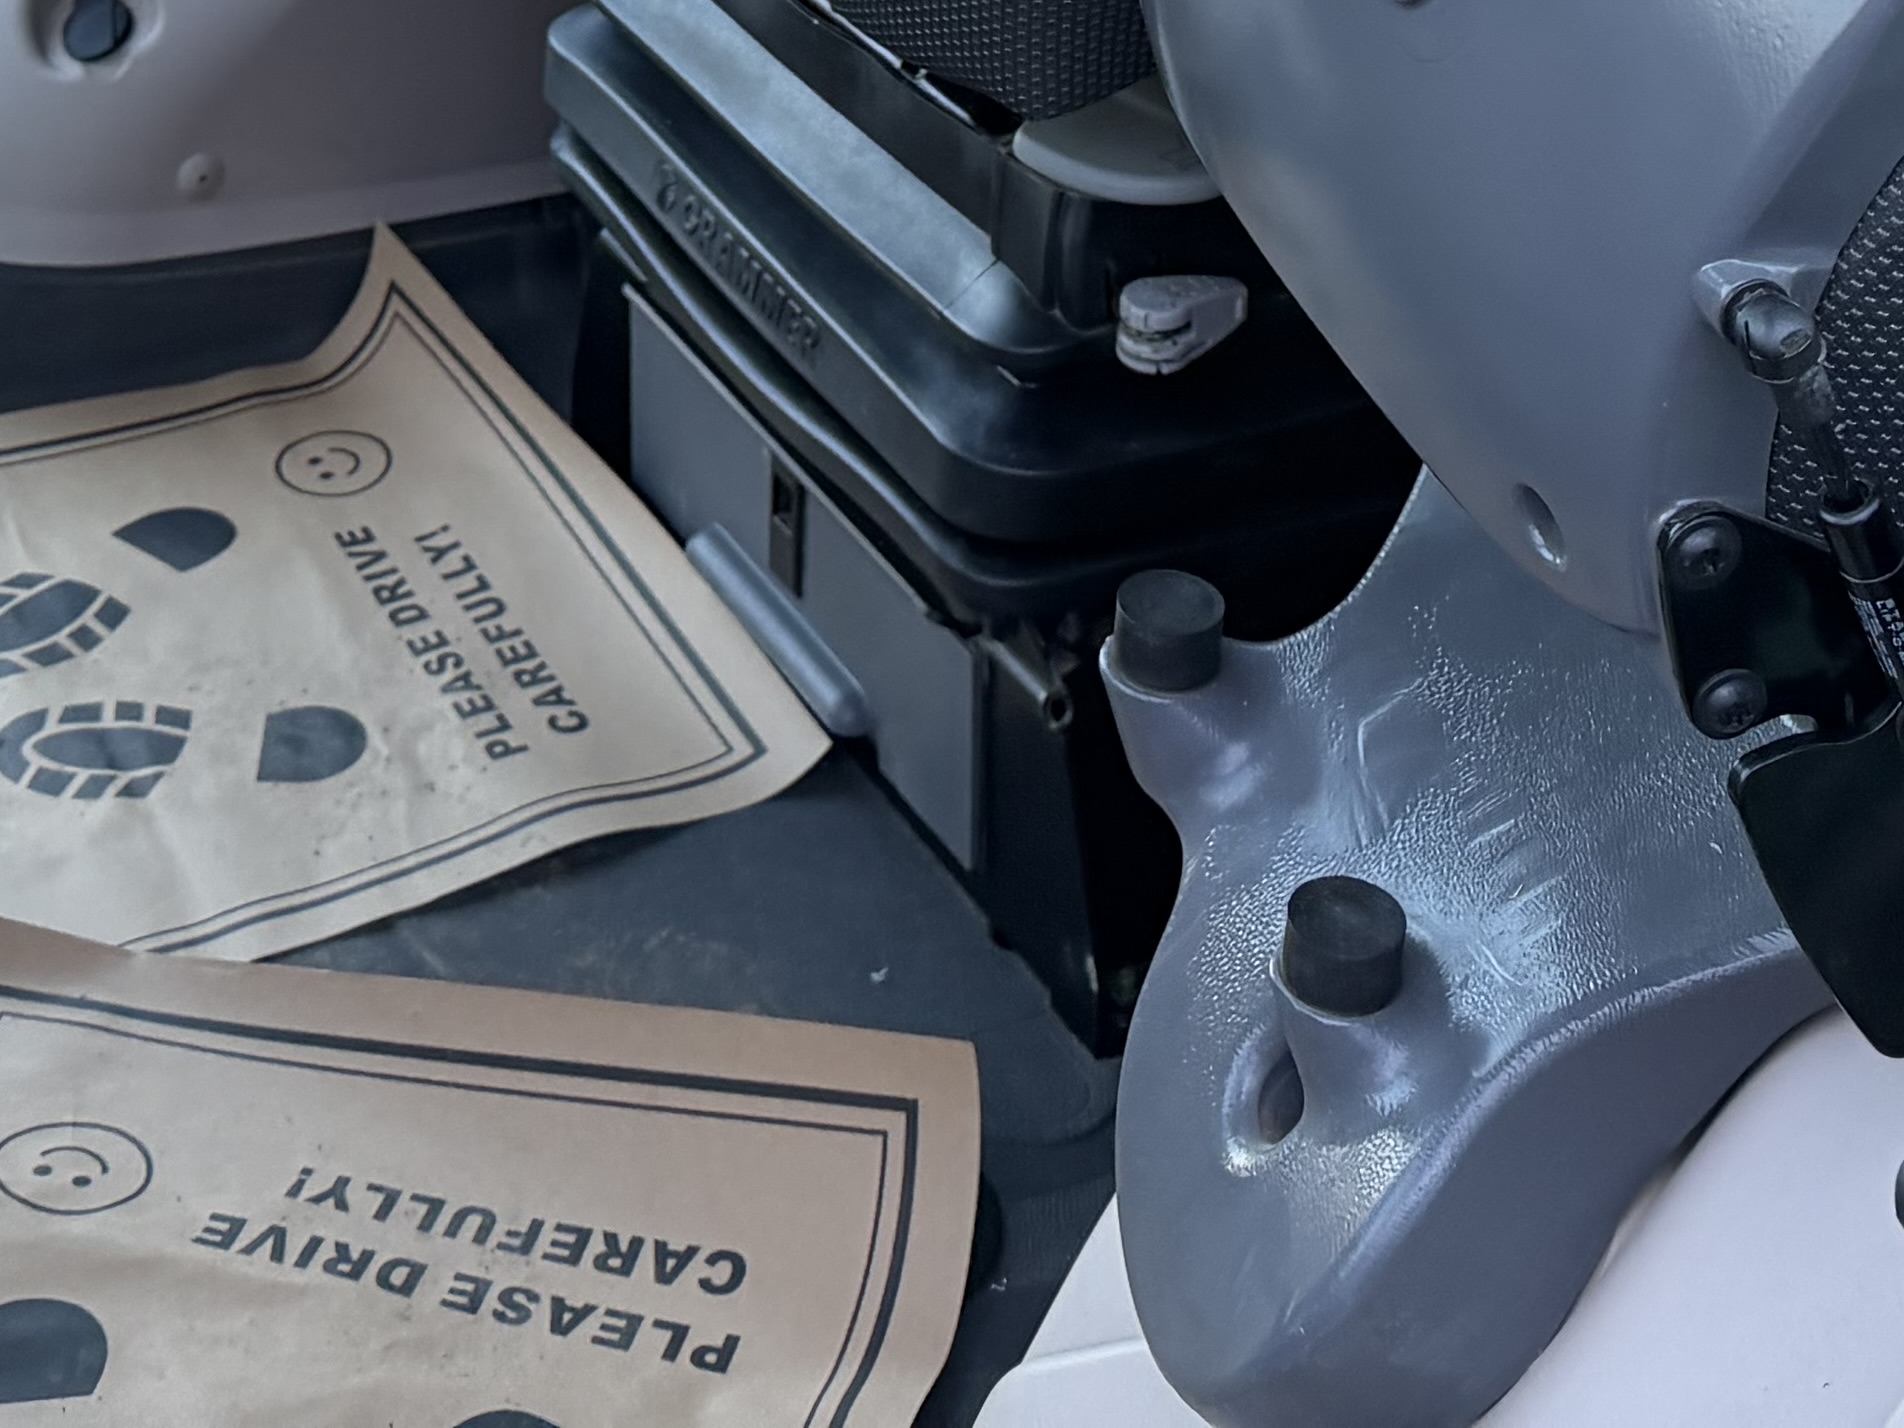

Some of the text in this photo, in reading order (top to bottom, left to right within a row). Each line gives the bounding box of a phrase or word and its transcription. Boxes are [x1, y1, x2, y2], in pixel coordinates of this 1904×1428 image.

[334, 525, 530, 760] PLEASE DRIVE
[413, 523, 589, 734] CAREFULLY!
[191, 1211, 741, 1376] PLEASE DRIVE
[284, 1166, 748, 1297] CAREFULLY!
